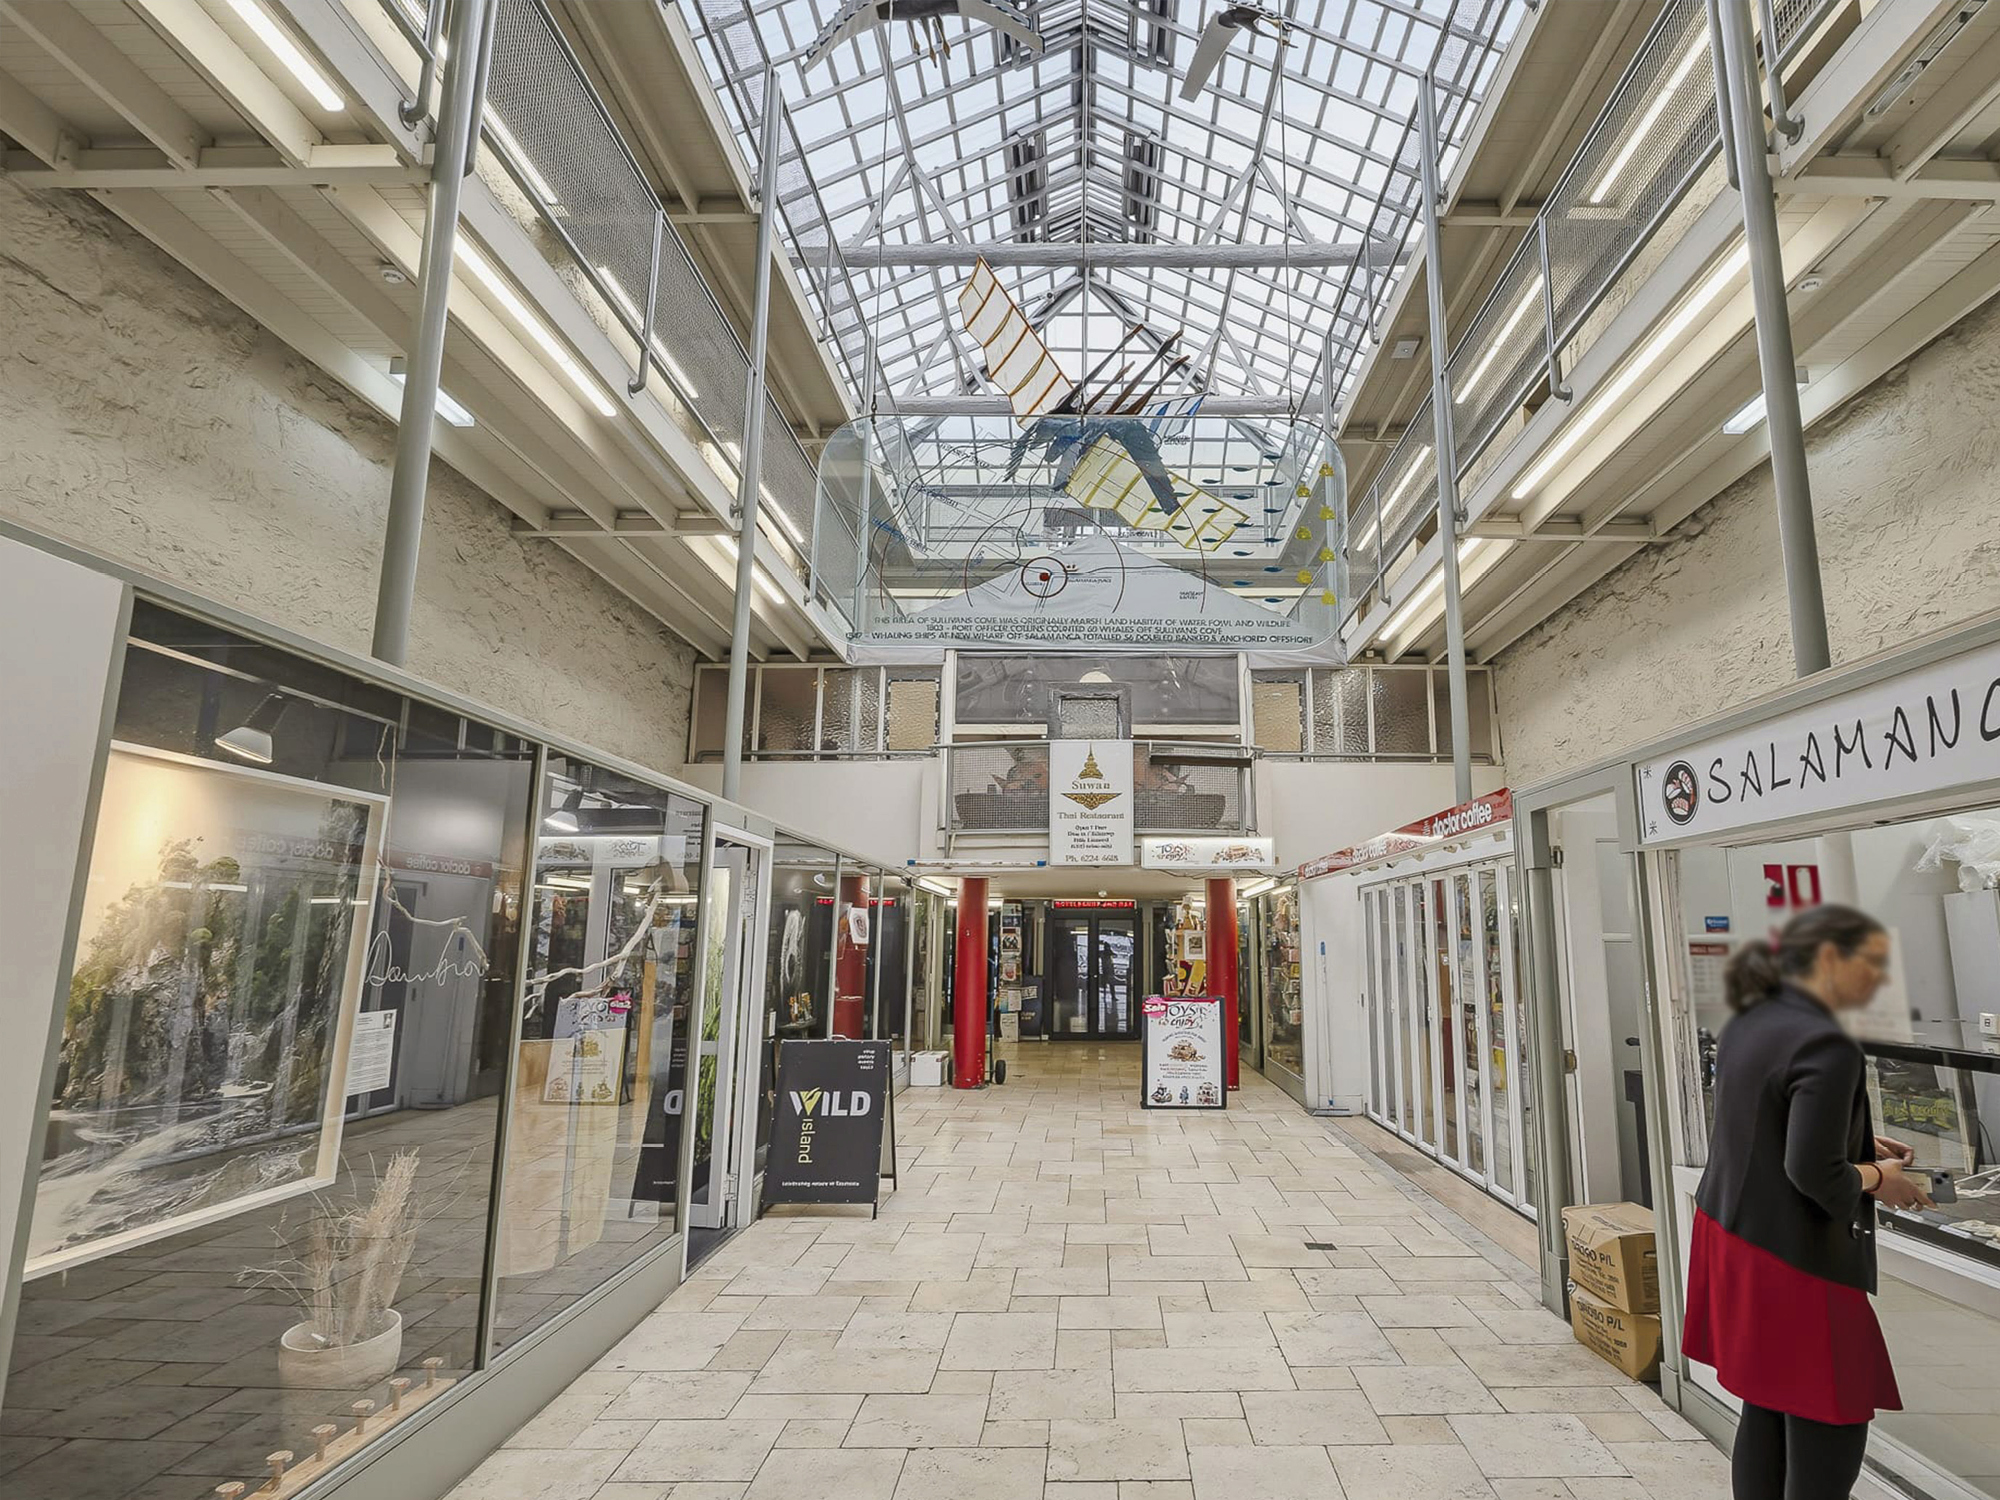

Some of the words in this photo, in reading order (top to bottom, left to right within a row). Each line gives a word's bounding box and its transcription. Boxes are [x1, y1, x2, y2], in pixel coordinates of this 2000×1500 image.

[1020, 617, 1070, 625] ORIGINALLY
[1129, 618, 1162, 626] HABITAT
[1179, 619, 1206, 627] WATER
[1234, 620, 1254, 628] AND
[1046, 625, 1085, 633] COUNTED
[1199, 627, 1223, 635] COVE
[1024, 633, 1081, 641] SALAMANCA
[1083, 633, 1122, 641] TOTALLED
[1135, 634, 1173, 642] DOUBLED
[1269, 636, 1313, 644] OFFSHORE
[1071, 780, 1111, 790] Suwan
[1432, 812, 1460, 836] doctor
[1460, 801, 1492, 830] coffee
[789, 1087, 871, 1117] WILD
[798, 1118, 816, 1163] island
